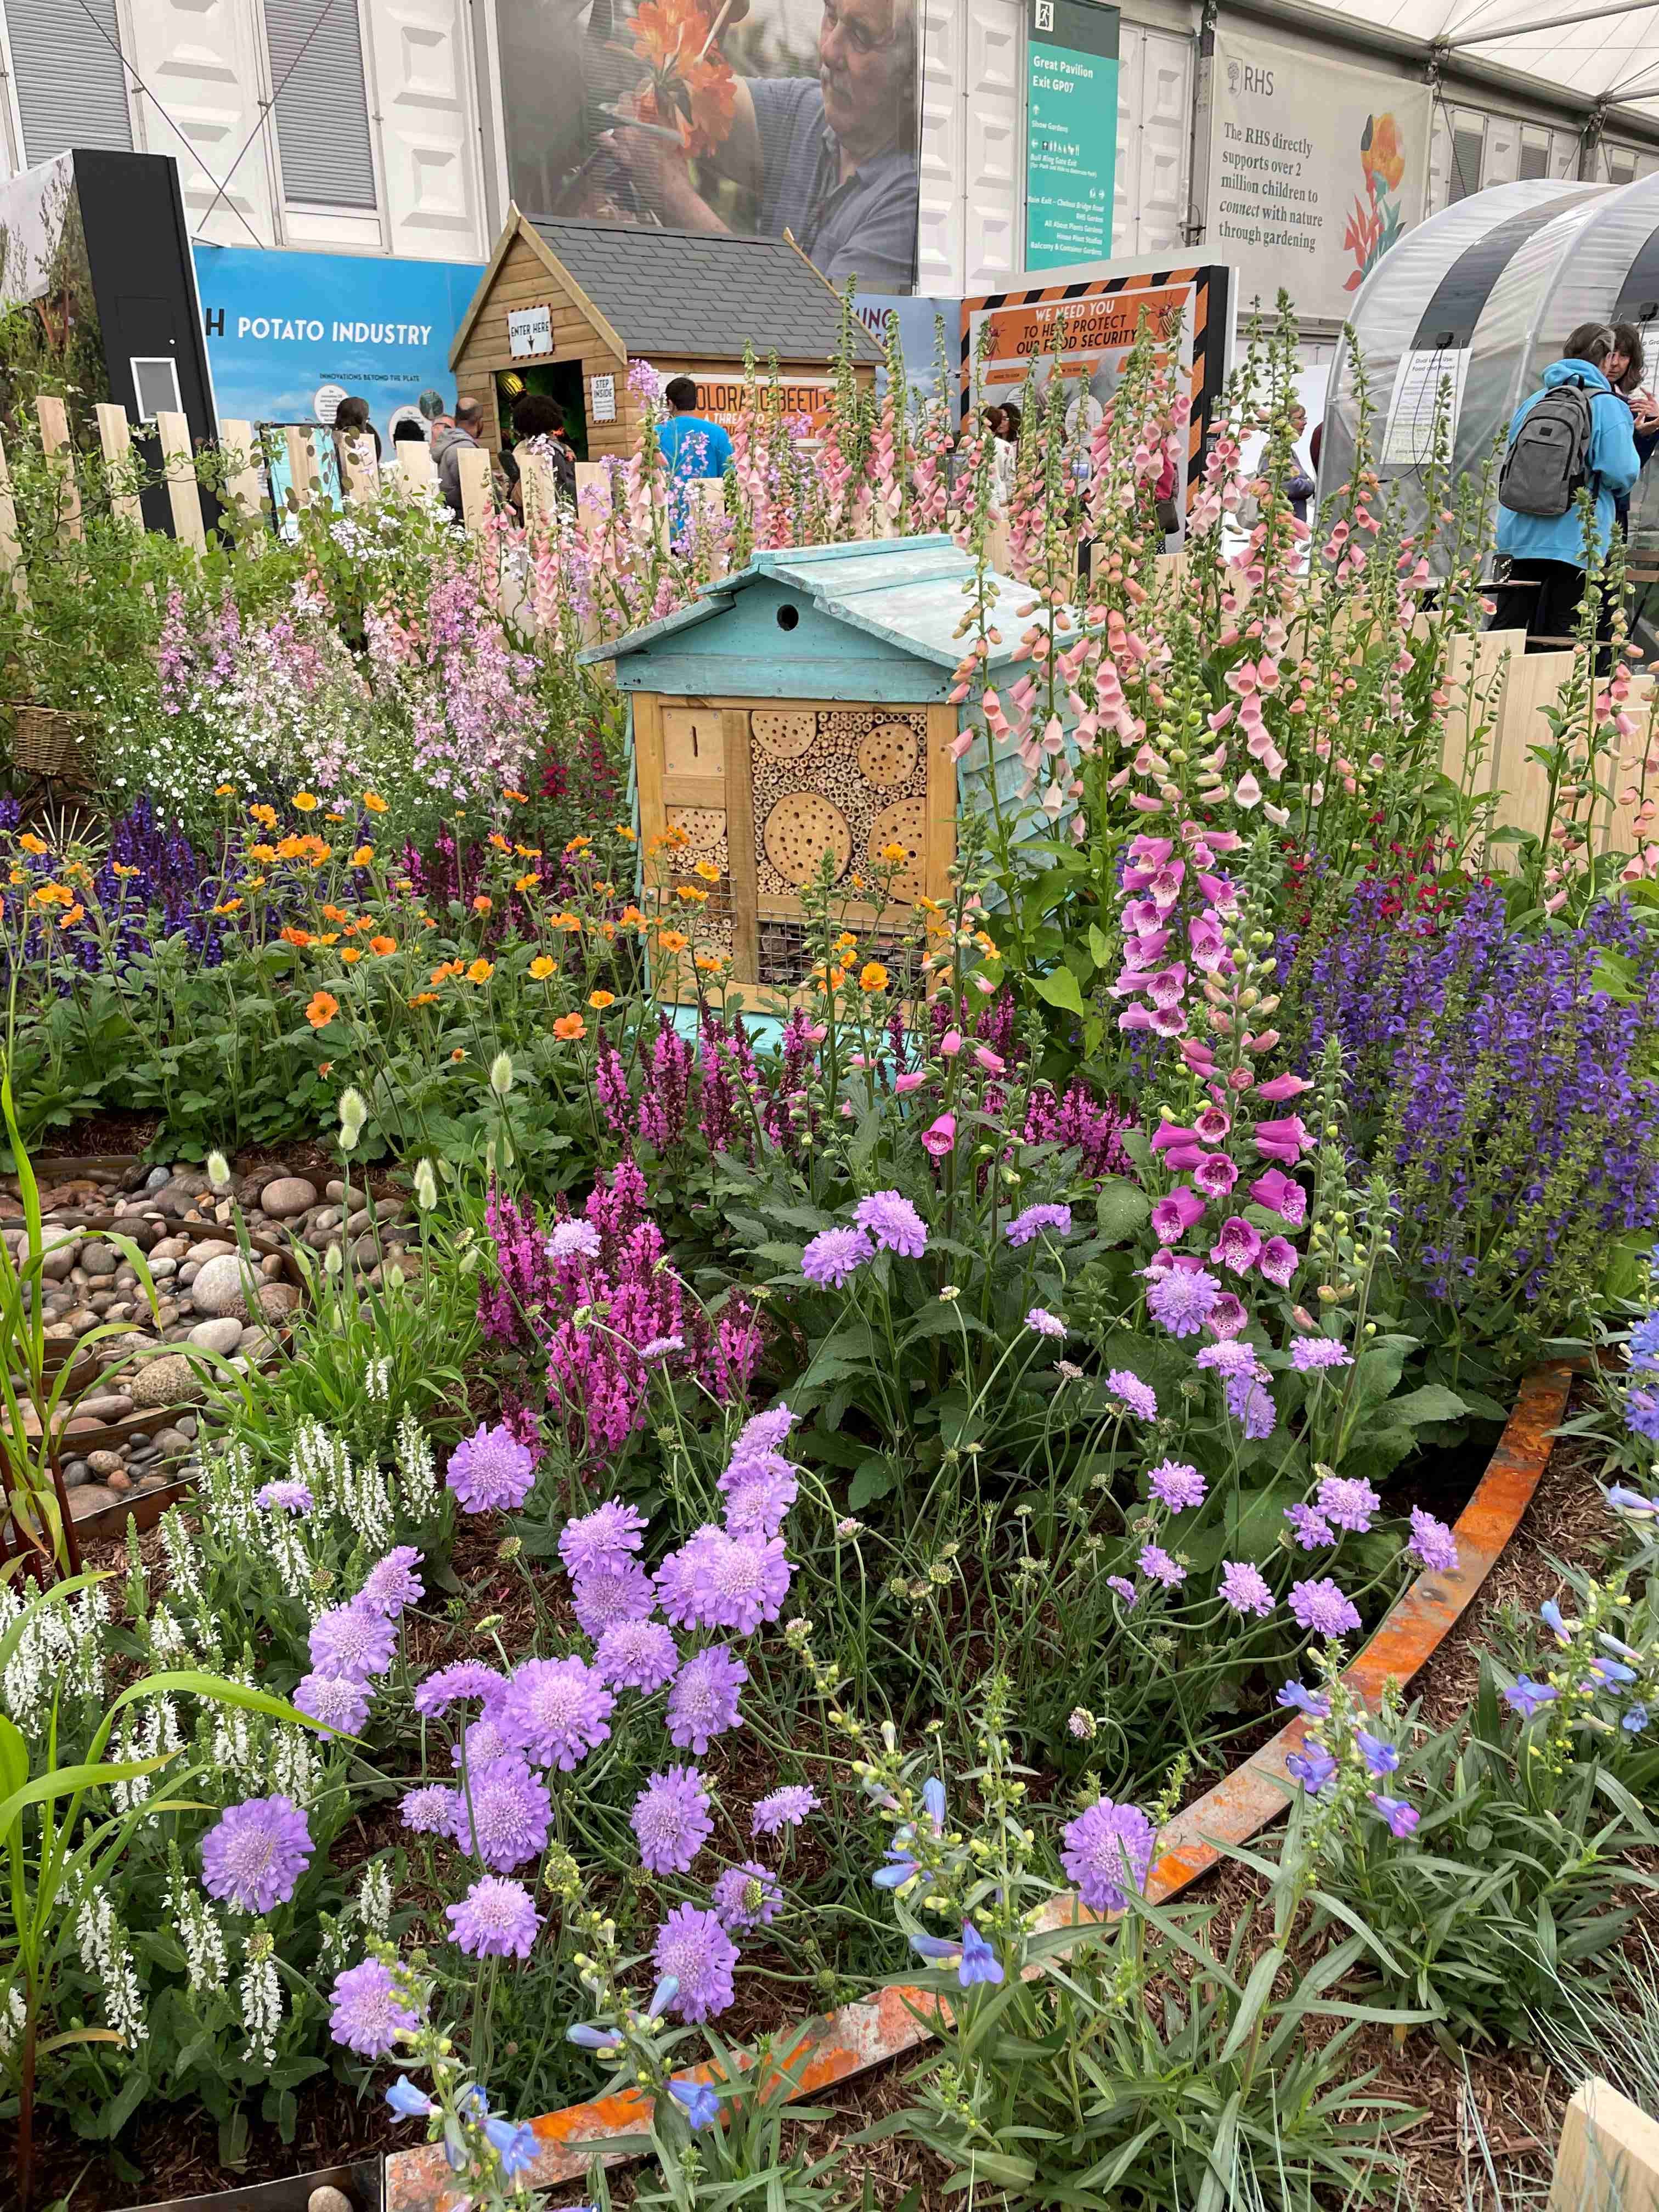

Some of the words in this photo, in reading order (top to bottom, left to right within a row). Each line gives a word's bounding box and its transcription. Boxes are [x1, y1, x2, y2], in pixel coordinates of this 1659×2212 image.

[1034, 55, 1058, 71] Great
[1060, 61, 1093, 78] Pavilion
[1033, 75, 1051, 89] Exit
[1053, 79, 1074, 93] GP07
[1244, 65, 1274, 97] RHS
[1031, 120, 1047, 129] Show
[1224, 122, 1242, 141] The
[1245, 127, 1270, 146] RHS
[1272, 132, 1313, 159] directly
[1222, 150, 1269, 172] supports
[1272, 161, 1293, 176] over
[1295, 162, 1302, 177] 2
[1221, 173, 1259, 194] million
[1262, 180, 1305, 201] children
[1308, 189, 1318, 203] to
[1220, 200, 1260, 218] connect
[1262, 205, 1287, 223] with
[1290, 210, 1323, 227] nature
[1220, 221, 1261, 245] through
[1263, 230, 1316, 253] gardening
[1036, 309, 1052, 321] WE
[1056, 304, 1085, 320] NEED
[1090, 300, 1115, 316] YOU
[238, 317, 324, 341] POTATO
[332, 321, 432, 345] INDUSTRY
[511, 325, 531, 337] ENTER
[533, 321, 549, 334] HERE
[1024, 325, 1038, 338] TO
[1042, 321, 1069, 337] HEP
[1073, 314, 1127, 332] PROTECT
[1081, 329, 1138, 348] SECURITY
[594, 388, 612, 398] INSIDE
[595, 379, 610, 388] STEP
